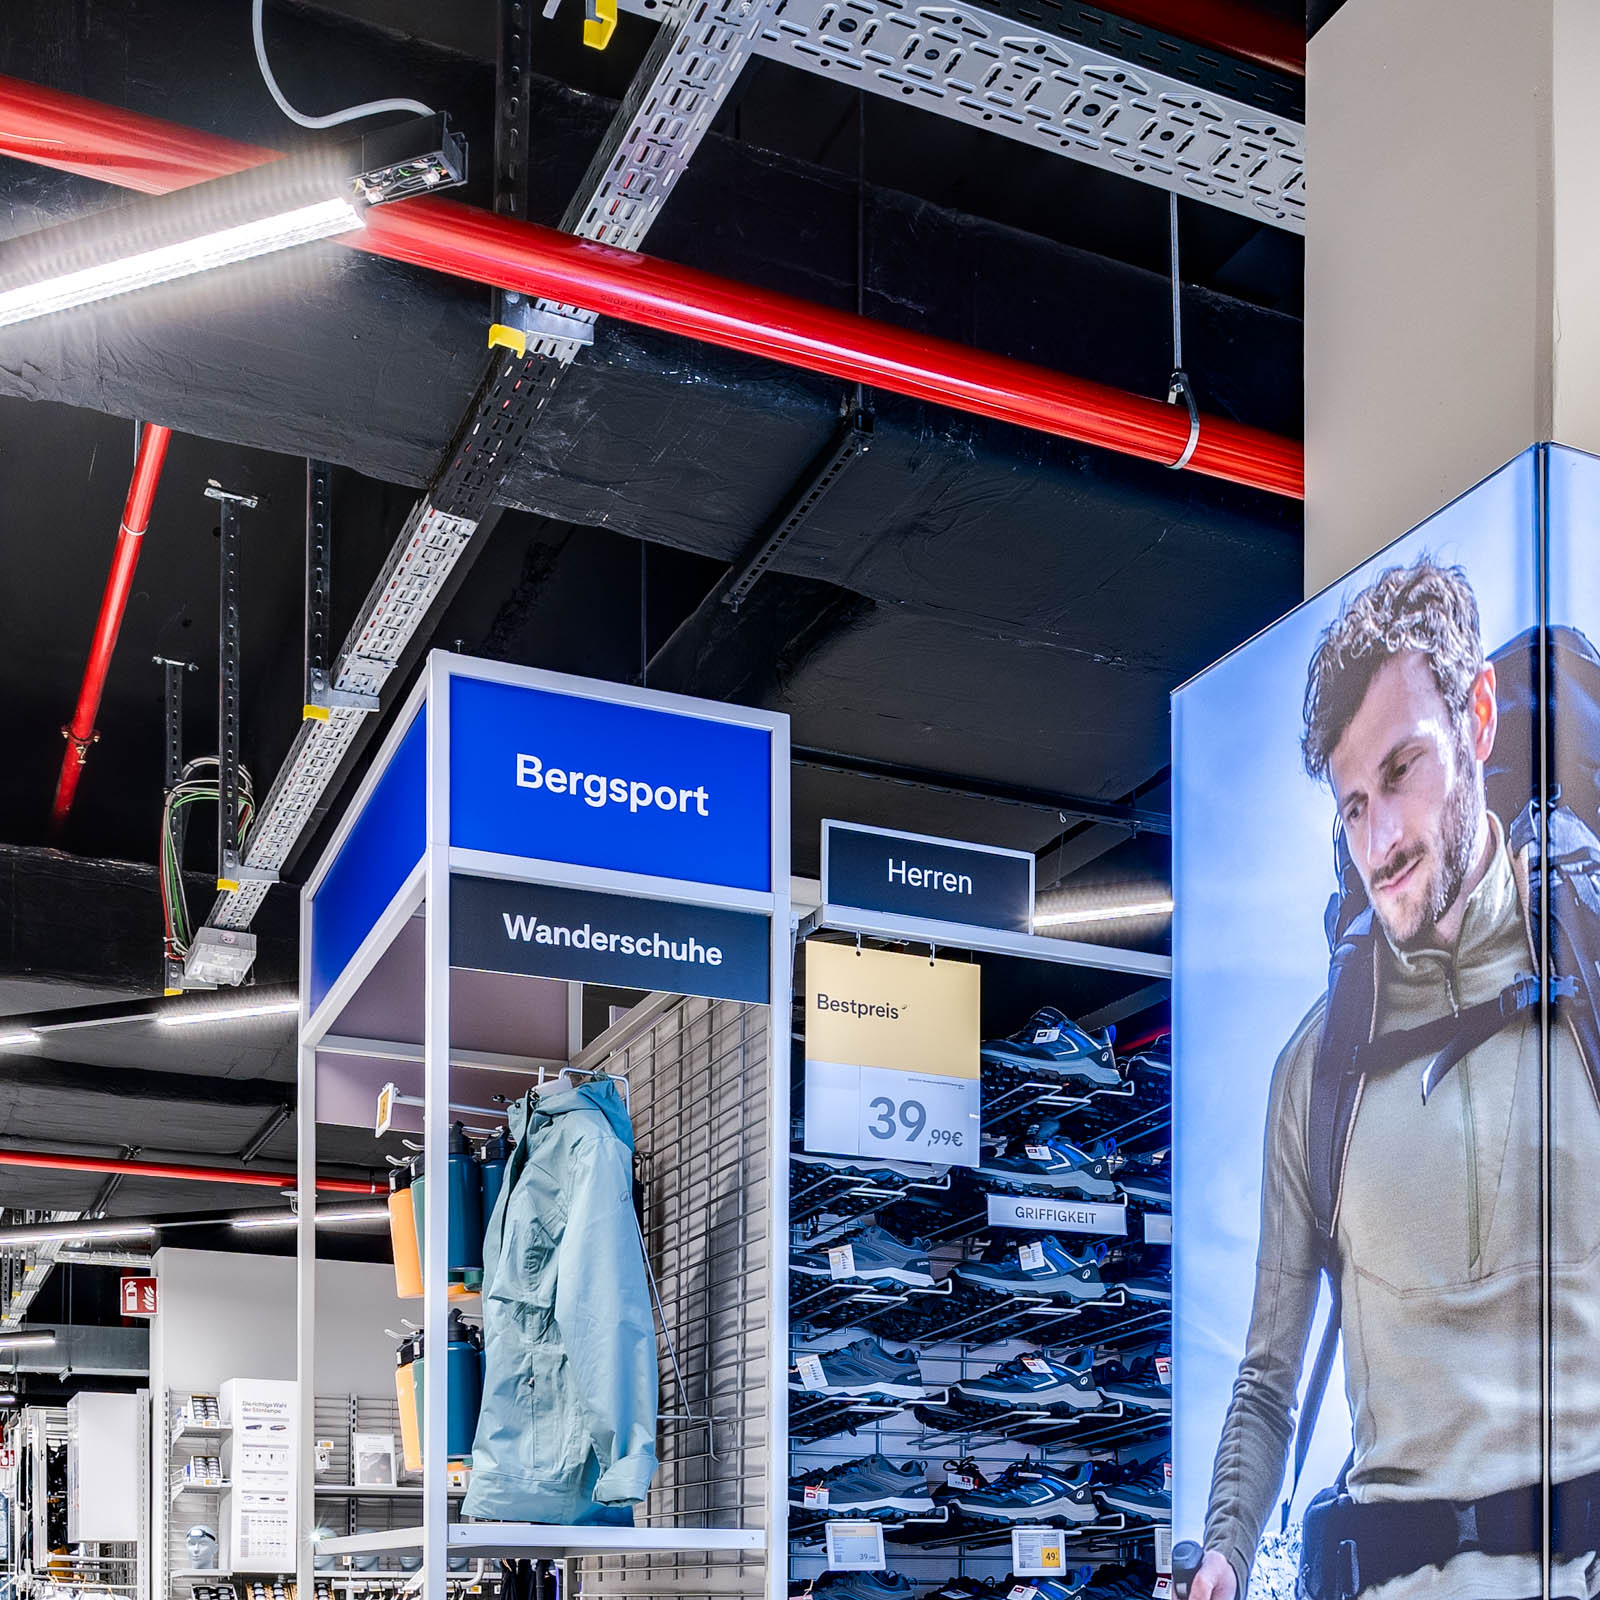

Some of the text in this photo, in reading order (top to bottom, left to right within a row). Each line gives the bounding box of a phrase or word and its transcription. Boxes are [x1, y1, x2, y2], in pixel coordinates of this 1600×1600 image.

[515, 753, 710, 817] Bergsport
[887, 859, 973, 895] Herren
[503, 914, 723, 968] Wanderschuhe
[816, 993, 900, 1020] Bestpreis
[1015, 1206, 1097, 1226] GRIFFIGKEIT
